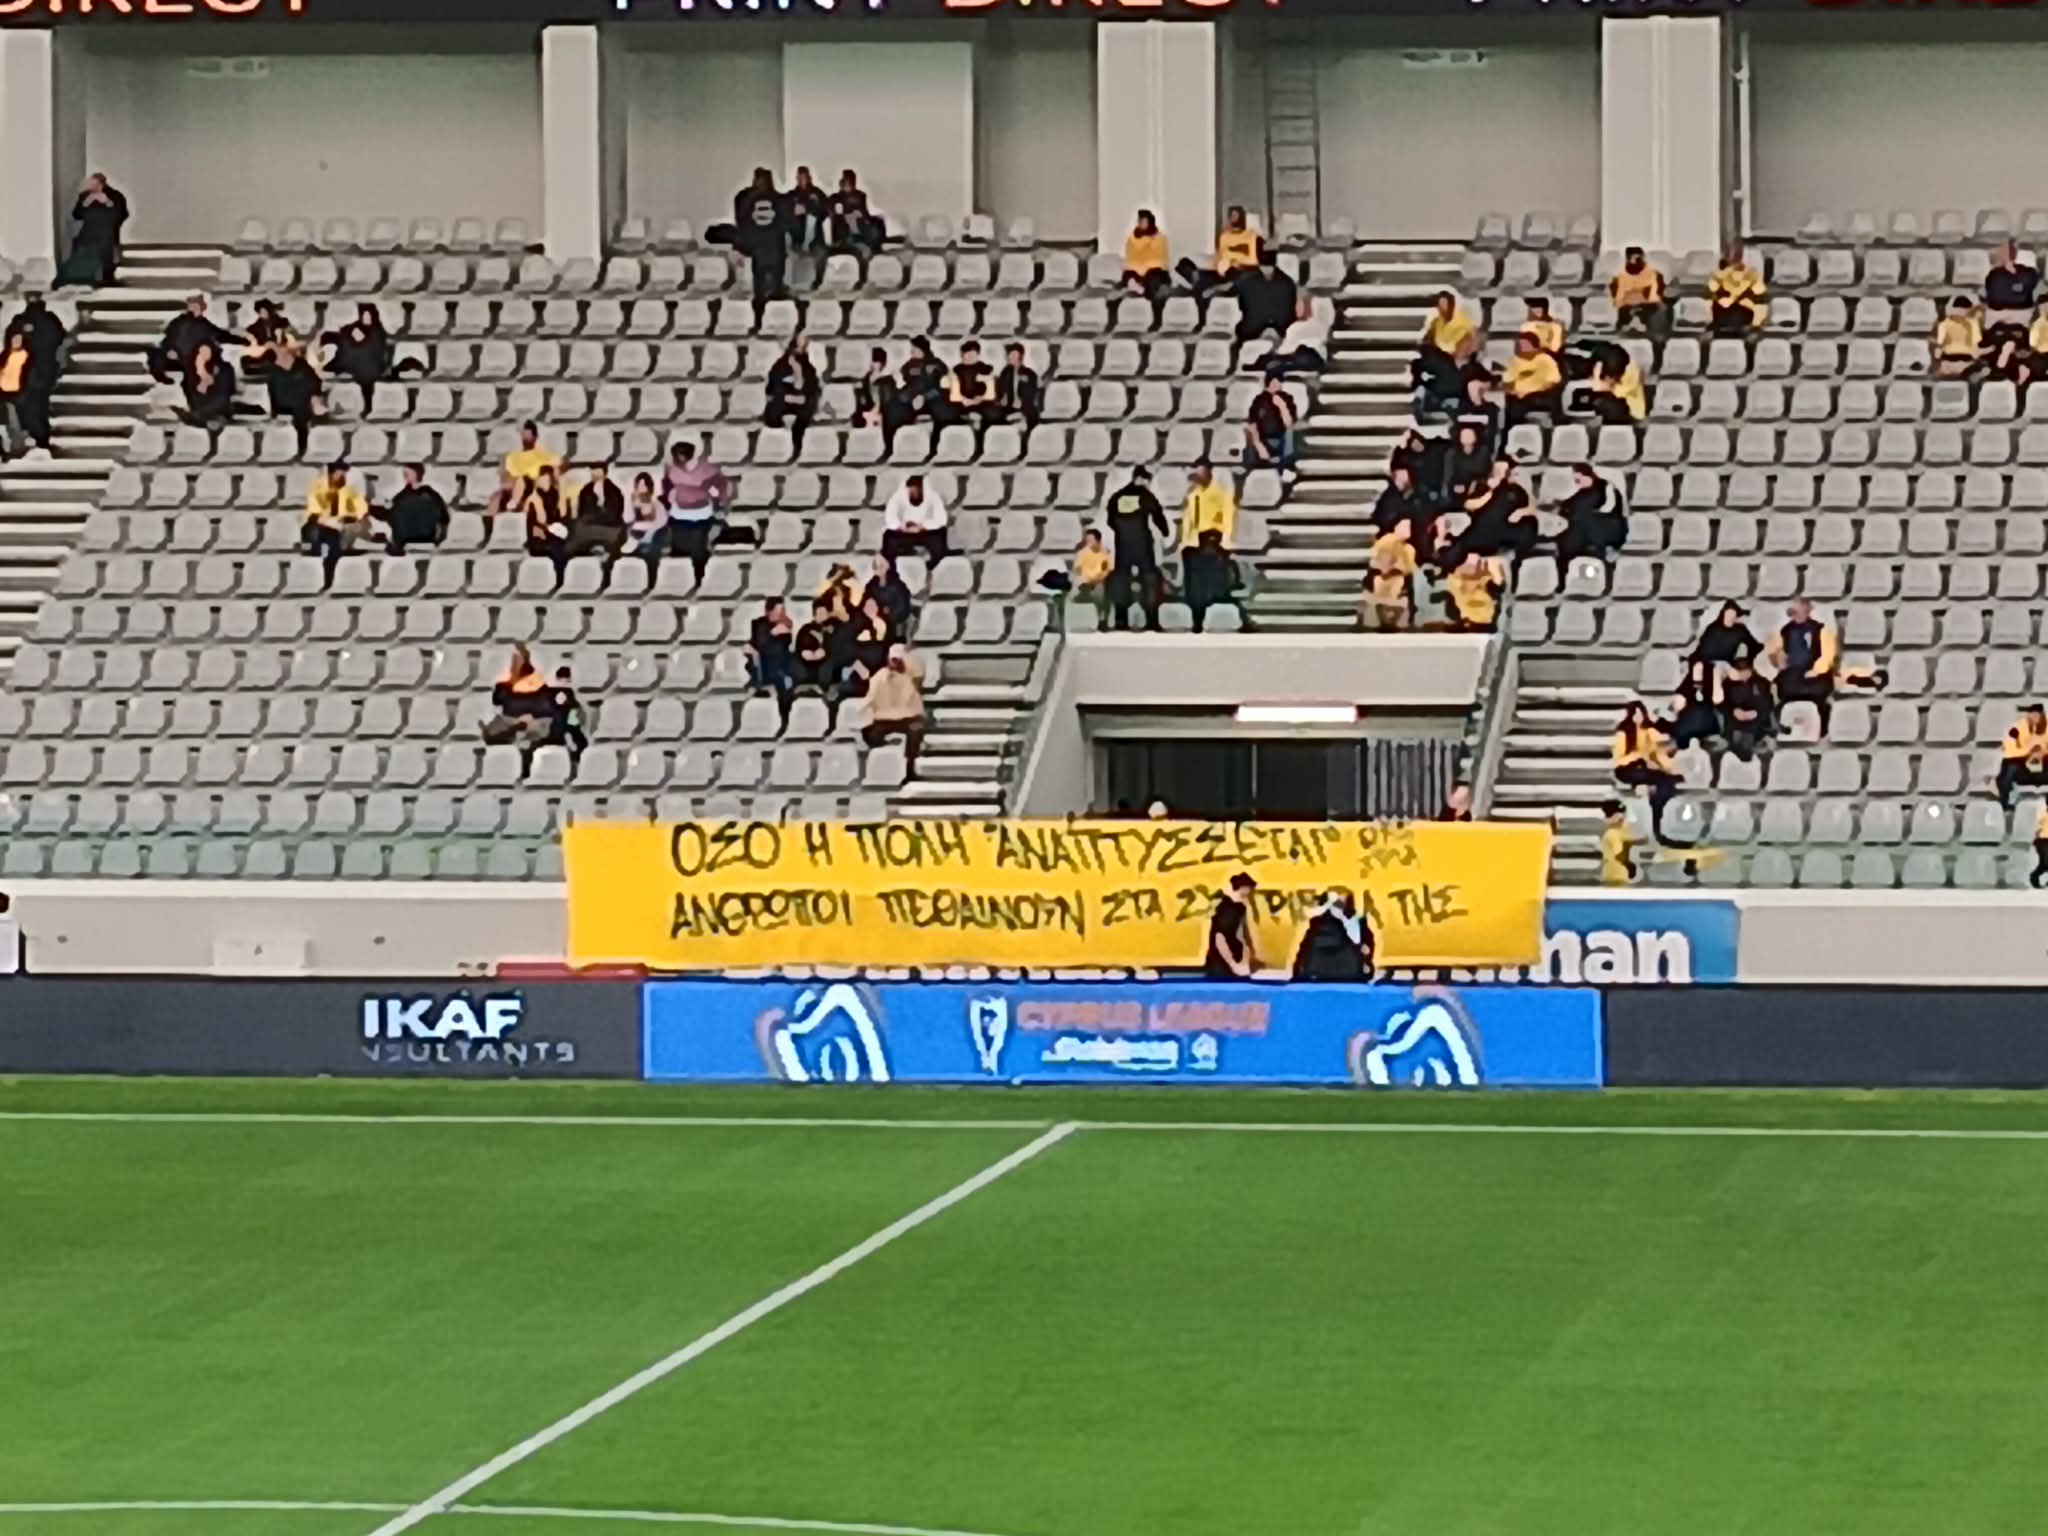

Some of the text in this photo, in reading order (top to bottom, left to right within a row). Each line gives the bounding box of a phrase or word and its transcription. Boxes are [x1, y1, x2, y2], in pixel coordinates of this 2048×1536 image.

[671, 821, 781, 877] ΟΣΟ
[804, 822, 833, 867] Η
[845, 821, 970, 868] ΠΟΛΗ
[1388, 884, 1469, 926] ΤΗΣ
